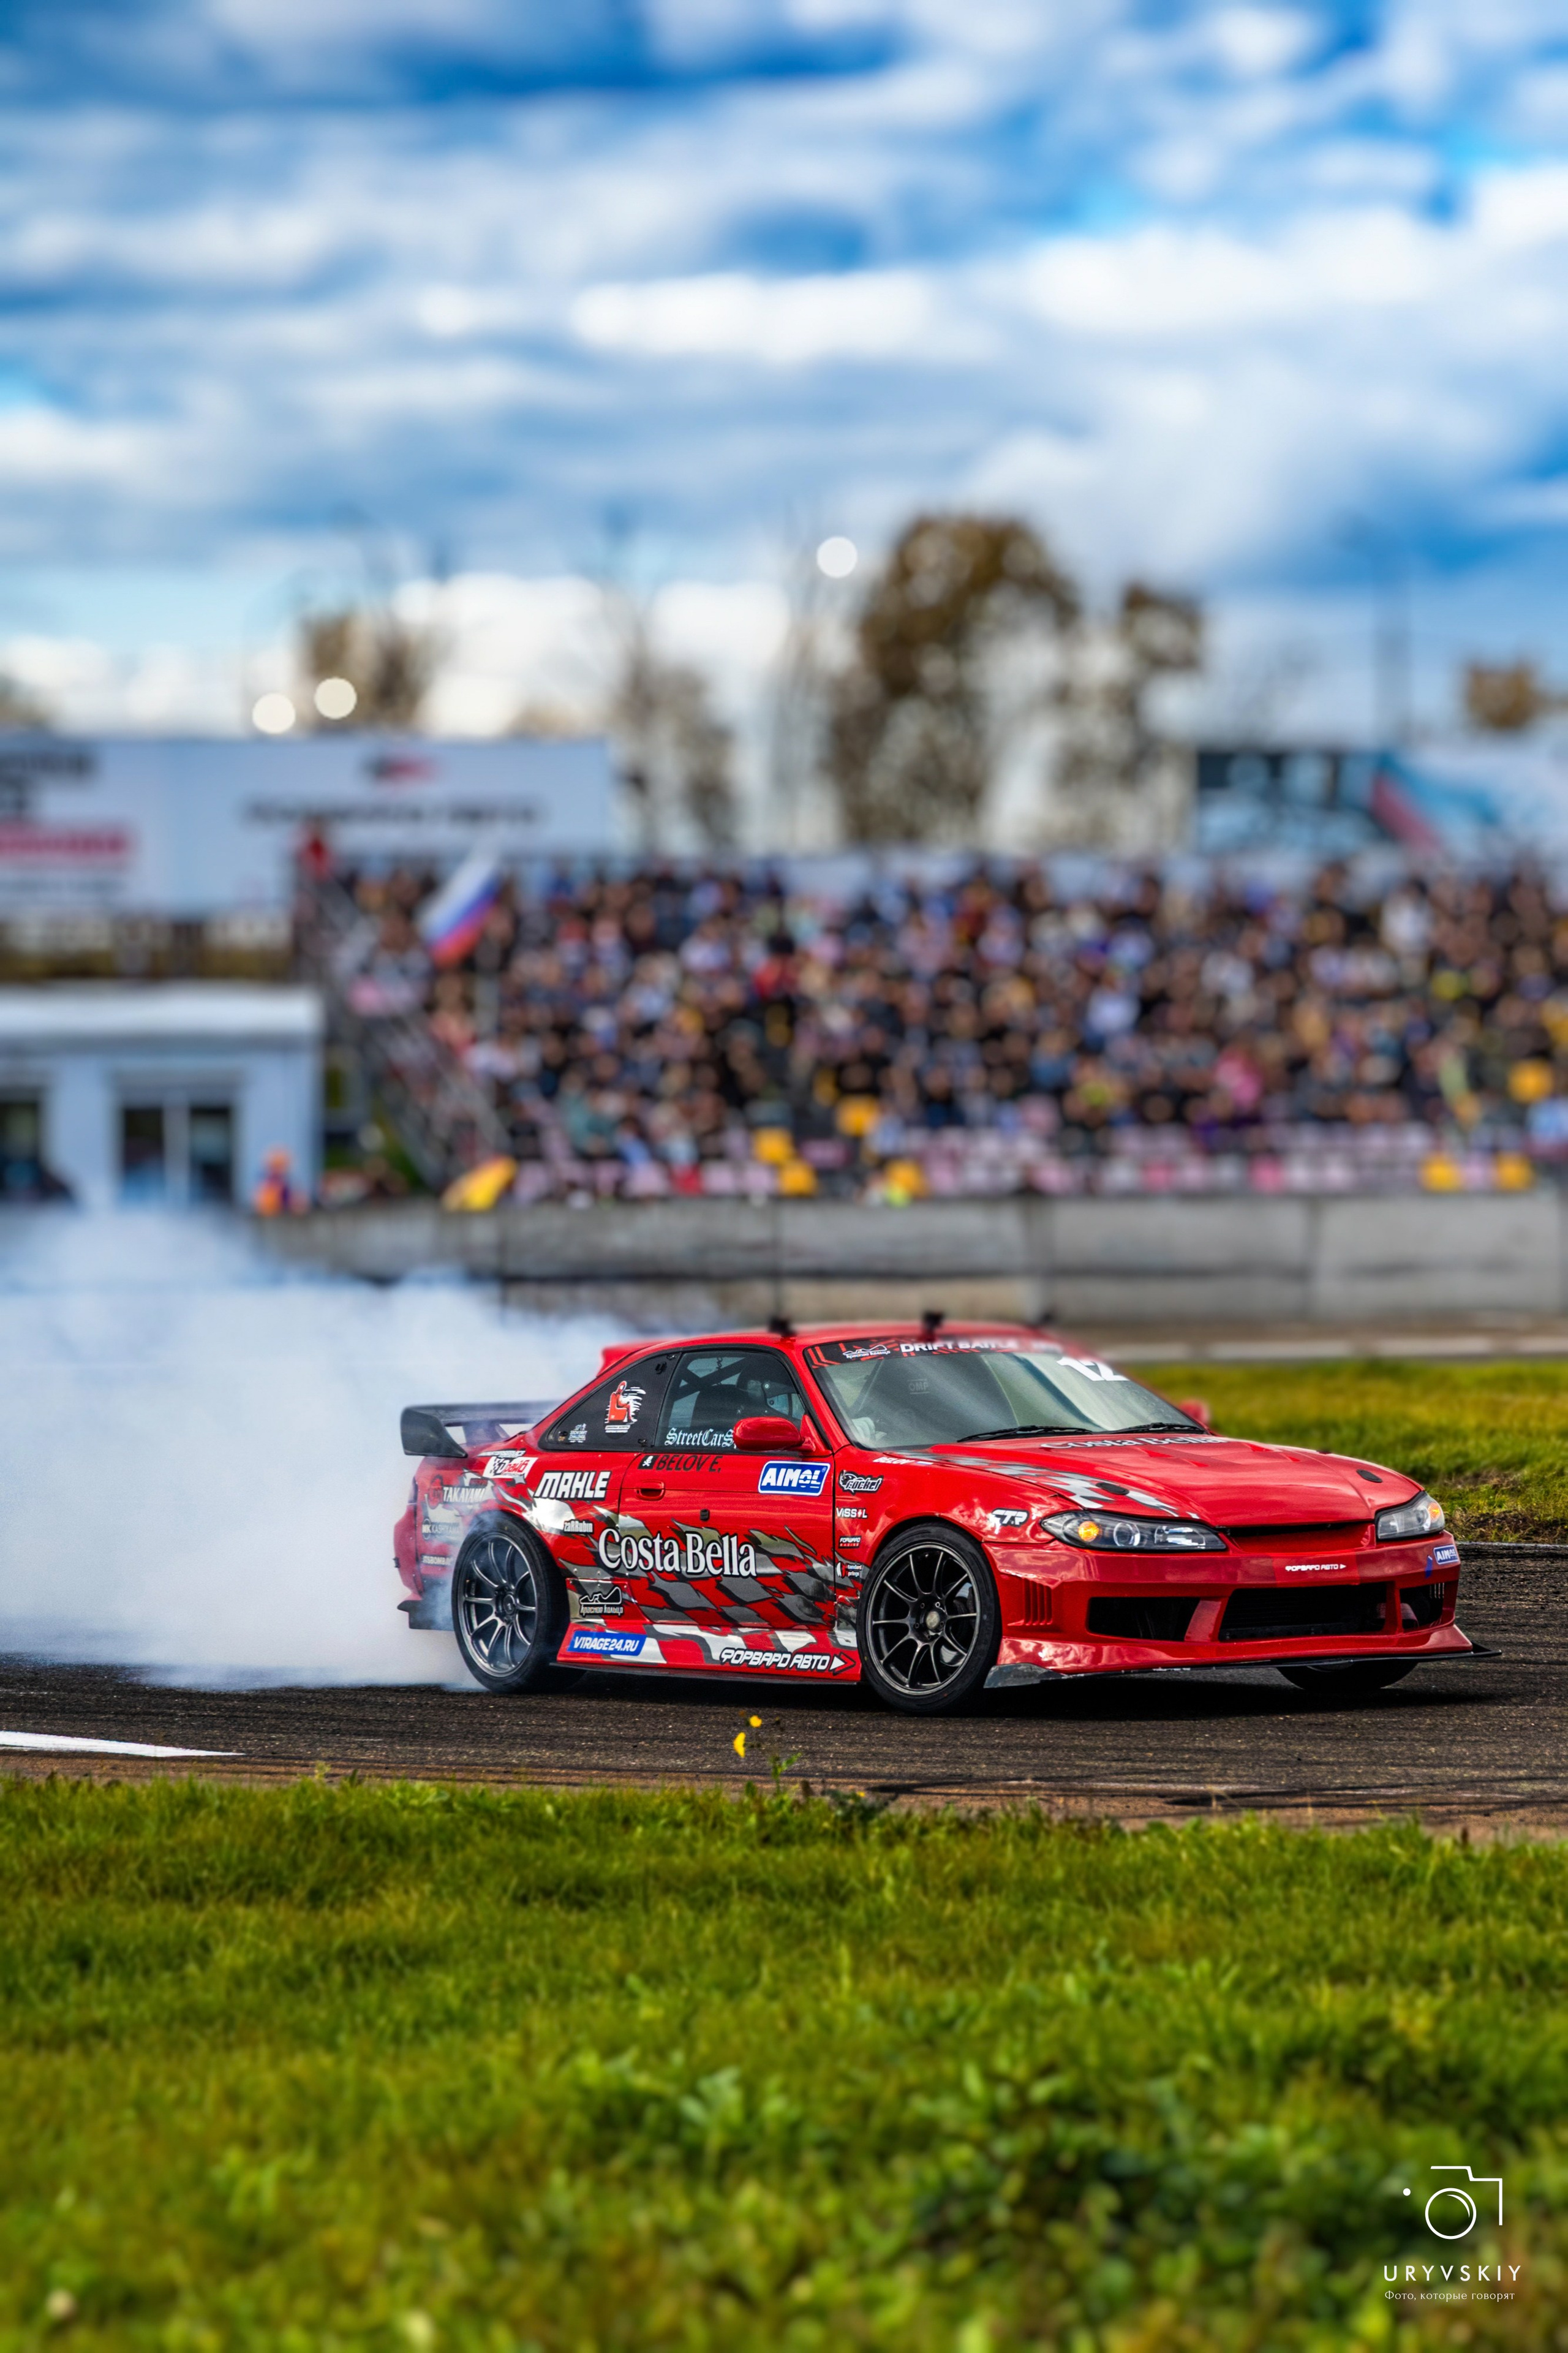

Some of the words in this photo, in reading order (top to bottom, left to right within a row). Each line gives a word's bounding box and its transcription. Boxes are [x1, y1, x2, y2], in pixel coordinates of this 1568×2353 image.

[1057, 1356, 1129, 1381] 12
[656, 1455, 710, 1470] BELOV
[709, 1456, 723, 1473] E.
[533, 1471, 611, 1498] MAHLE
[761, 1468, 821, 1489] AIMOL
[442, 1486, 486, 1503] TAKAYAMA
[598, 1528, 681, 1572] Costa
[685, 1533, 756, 1577] Bella
[573, 1636, 639, 1652] VIRAGE24.RU
[721, 1649, 791, 1667] ФОРВАРД
[790, 1654, 830, 1671] АВТО
